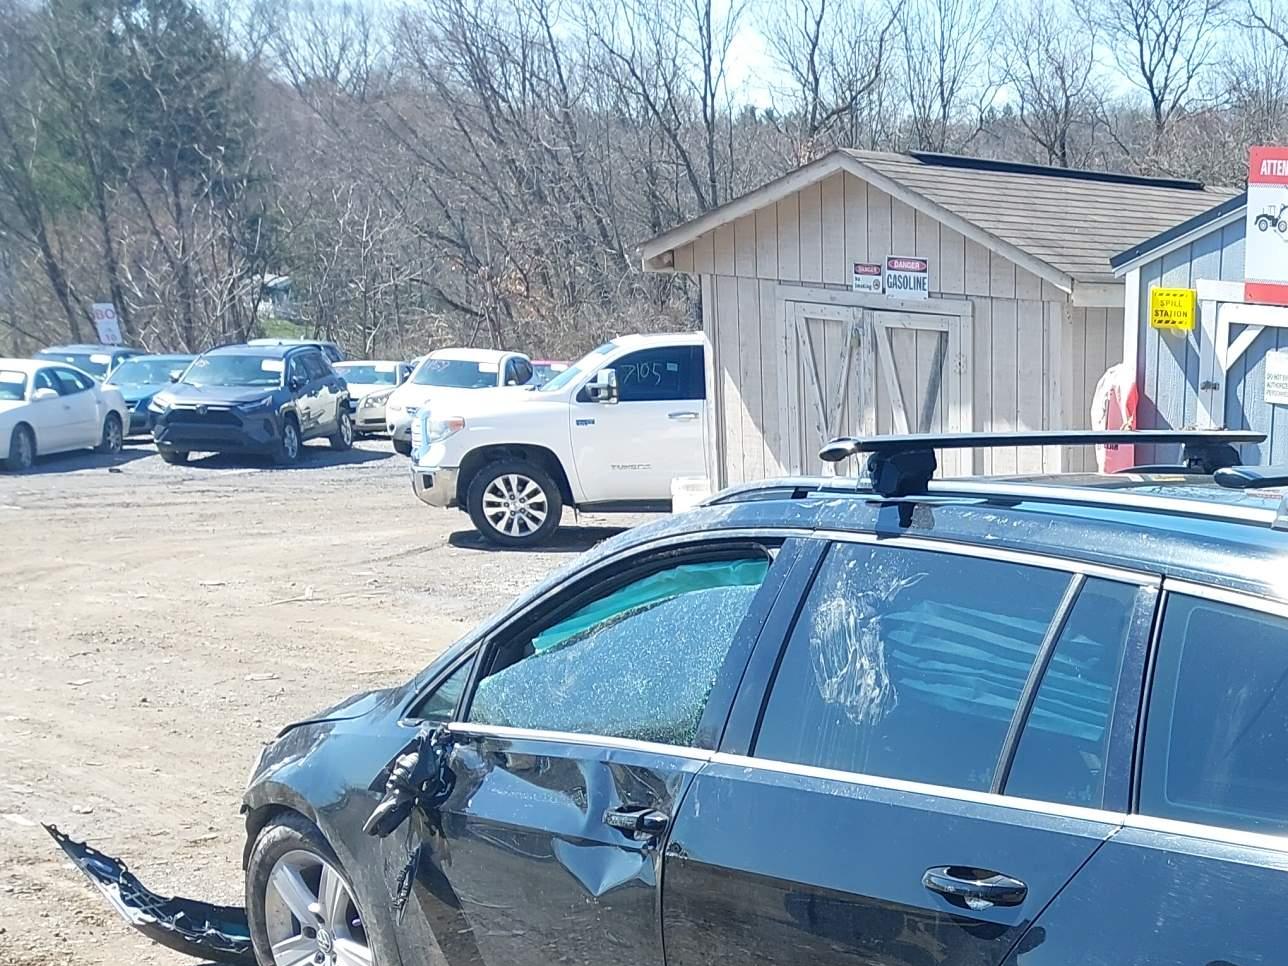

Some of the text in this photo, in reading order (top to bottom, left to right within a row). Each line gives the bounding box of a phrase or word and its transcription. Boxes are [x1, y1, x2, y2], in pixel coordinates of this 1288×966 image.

[886, 273, 928, 292] GASOLINE
[1160, 299, 1183, 308] SPILL
[1154, 309, 1188, 318] STATION
[621, 362, 663, 385] 7105
